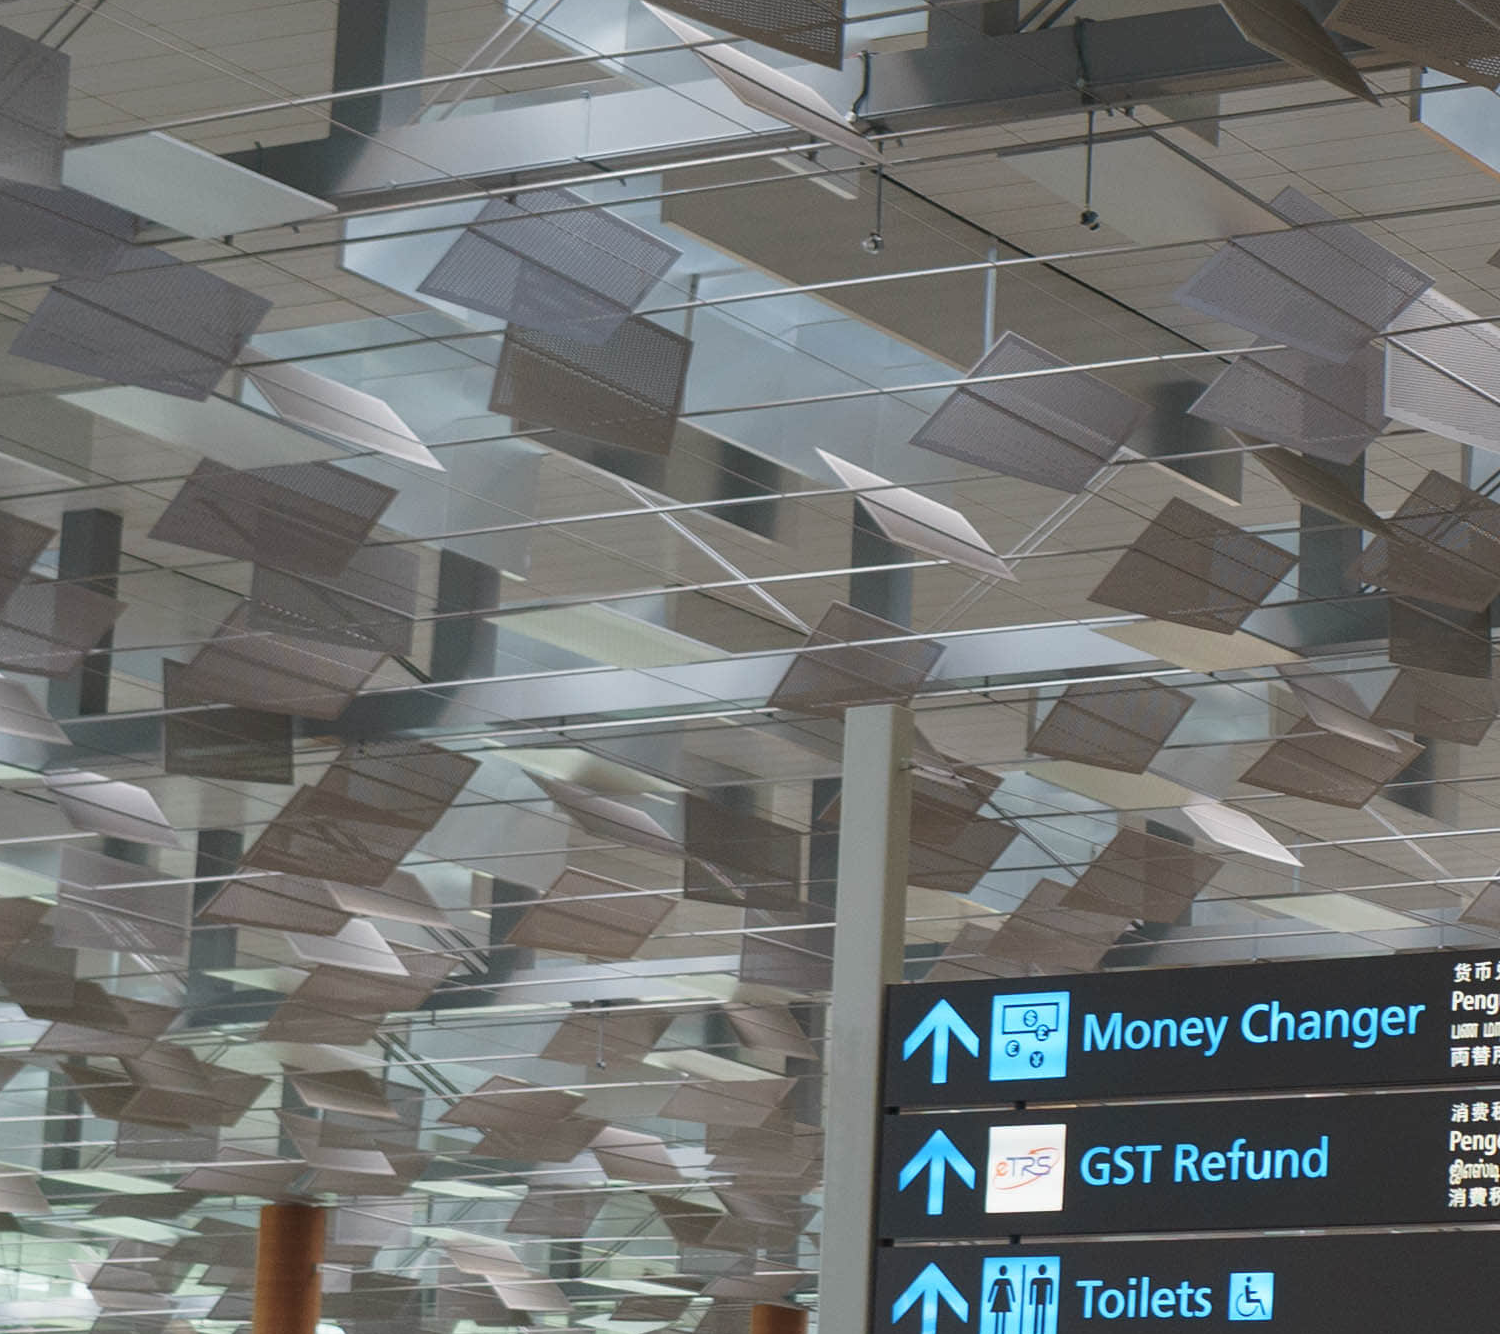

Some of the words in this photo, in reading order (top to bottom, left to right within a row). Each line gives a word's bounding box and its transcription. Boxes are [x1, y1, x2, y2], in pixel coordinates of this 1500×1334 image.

[1082, 1011, 1229, 1057] Money
[1241, 1001, 1426, 1049] Changer
[995, 1154, 1053, 1178] eTRS
[1079, 1144, 1163, 1187] GST
[1174, 1135, 1330, 1183] Refund
[1075, 1276, 1213, 1320] Toilets
